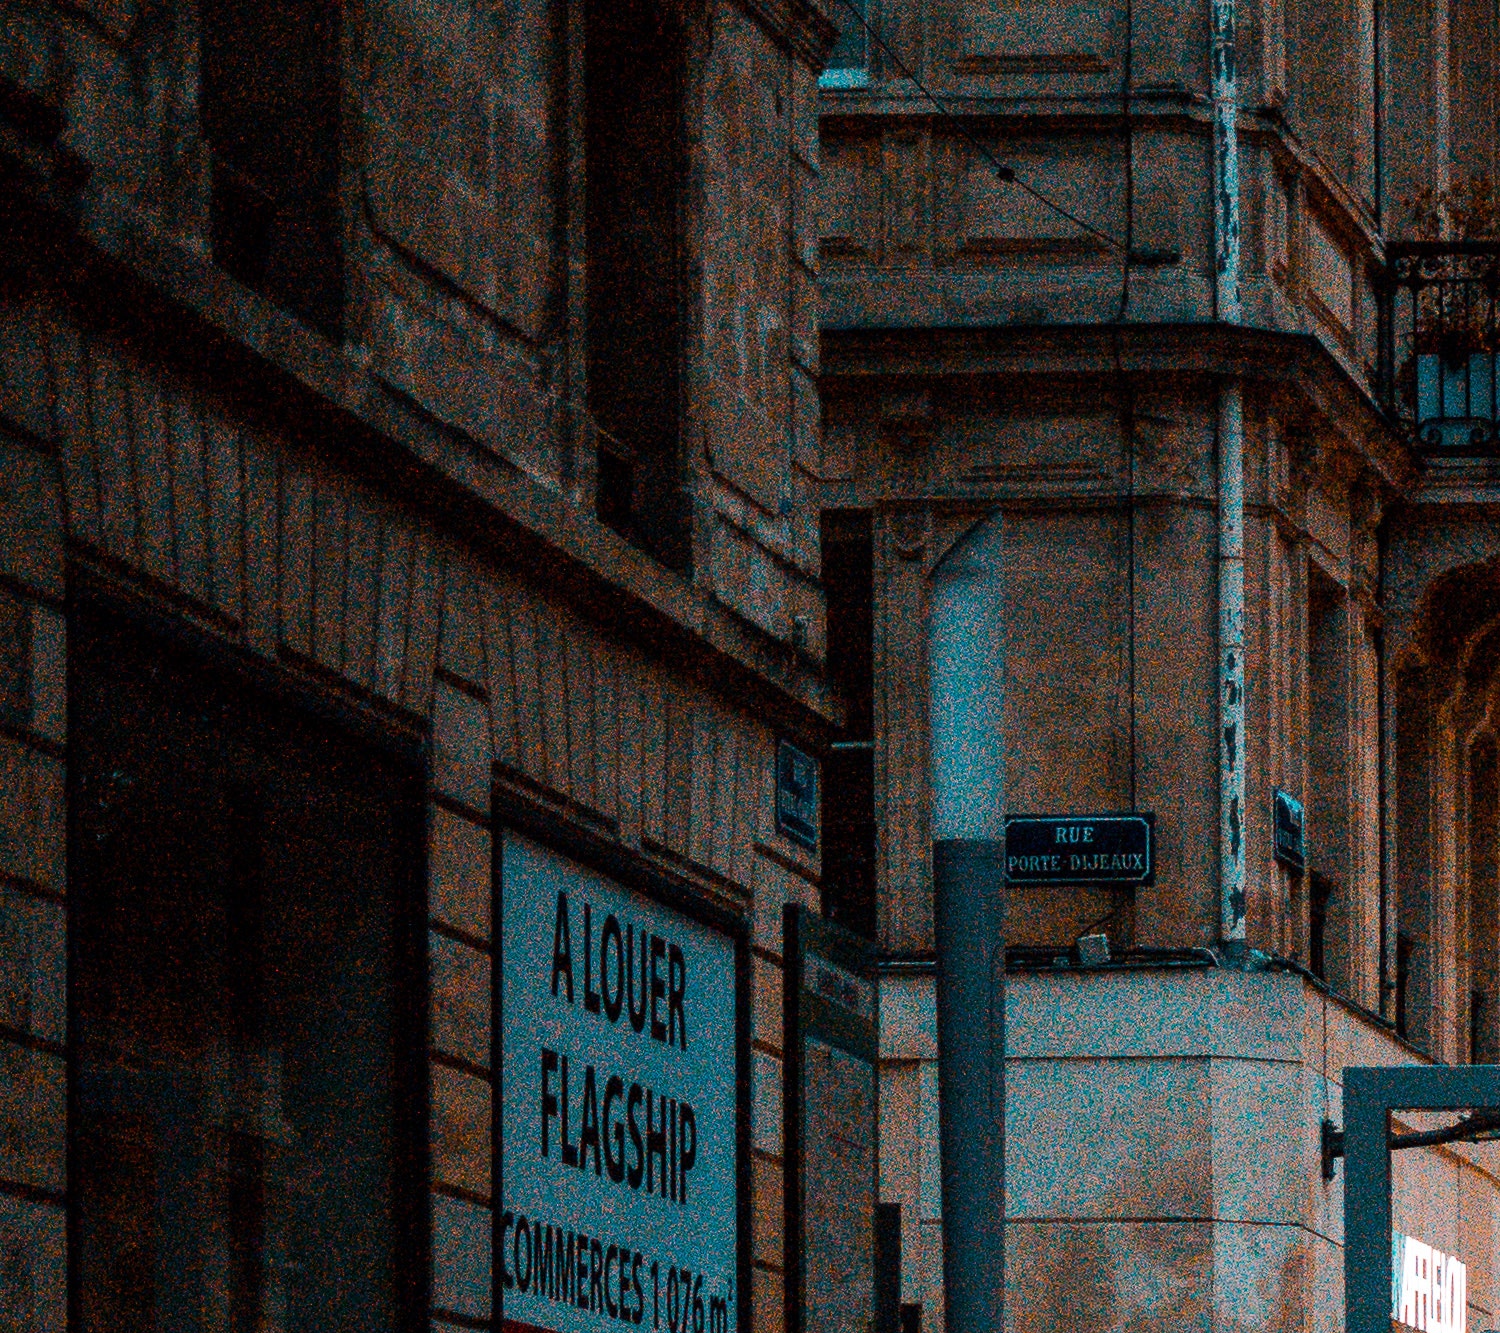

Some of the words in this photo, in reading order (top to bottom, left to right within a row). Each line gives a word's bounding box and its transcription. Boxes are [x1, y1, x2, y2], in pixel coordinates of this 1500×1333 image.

[1008, 853, 1144, 872] PORTE-DIJEAUX
[1055, 826, 1095, 844] RUE
[551, 890, 574, 1004] A
[584, 903, 687, 1051] LOUER
[542, 1046, 697, 1205] FLAGSHIP
[501, 1211, 644, 1325] COMMERCES
[649, 1262, 660, 1330] 1
